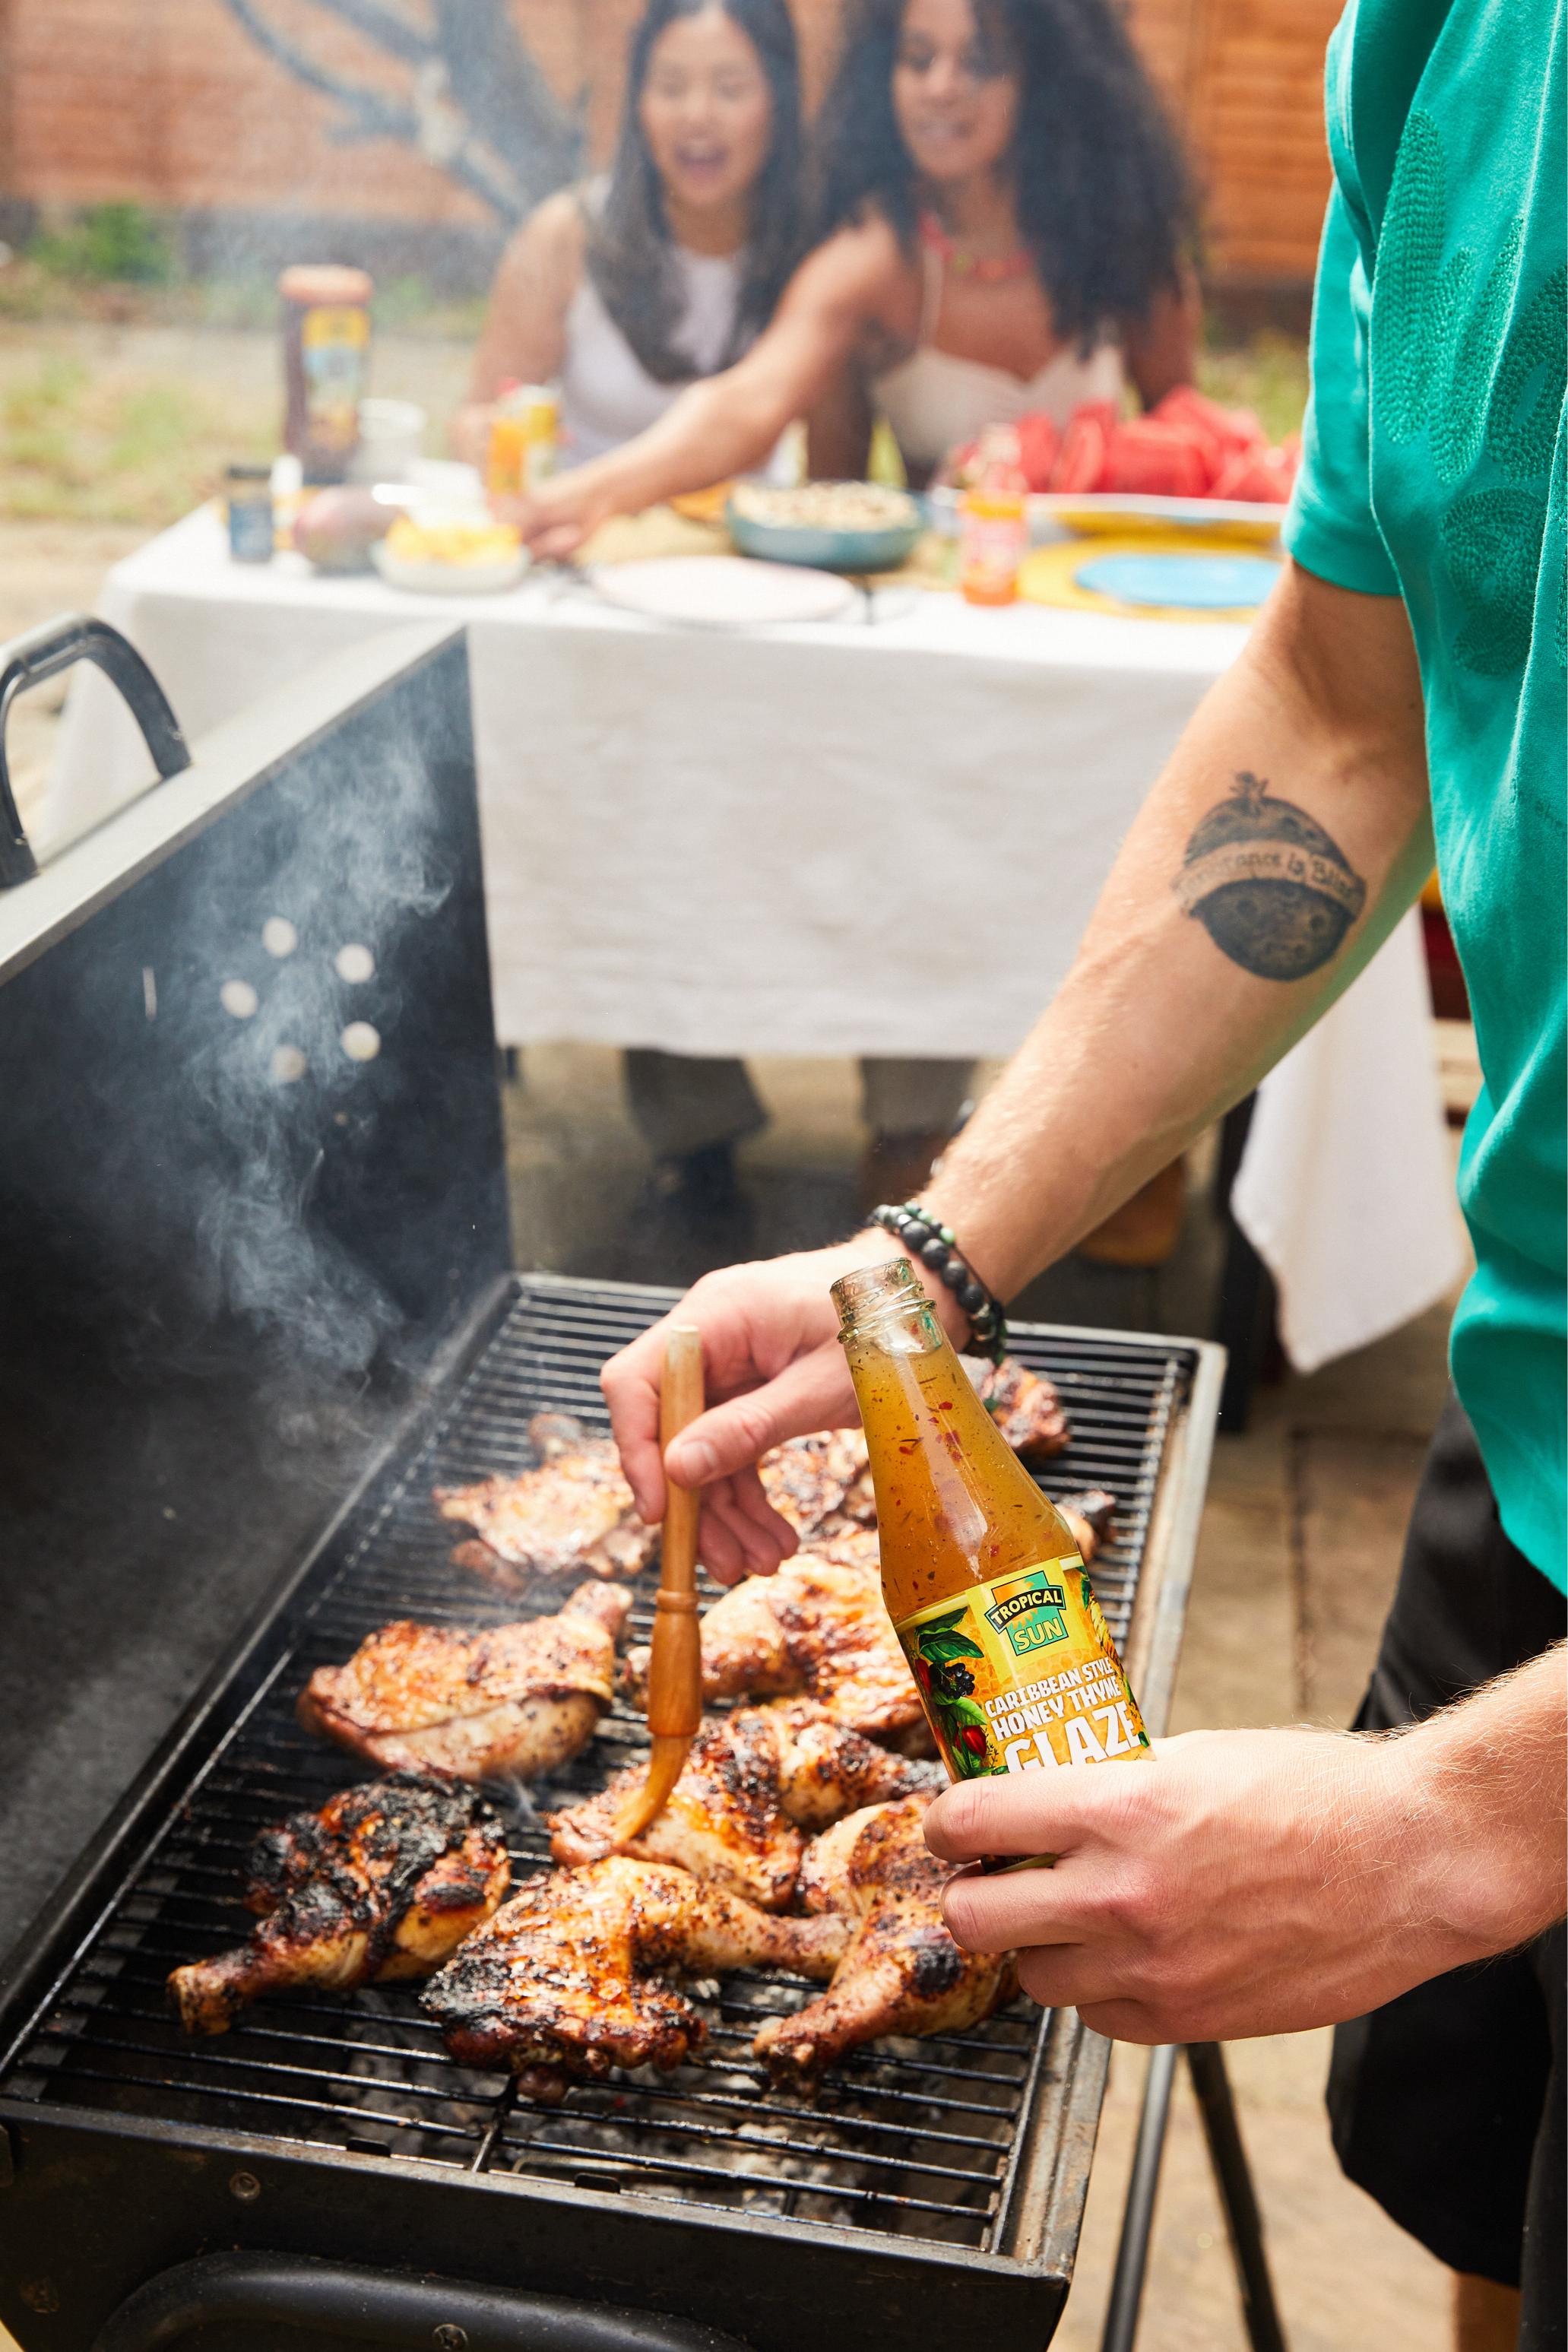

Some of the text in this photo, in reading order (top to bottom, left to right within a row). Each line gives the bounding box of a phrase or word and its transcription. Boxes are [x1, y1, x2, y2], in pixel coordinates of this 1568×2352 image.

[990, 1590, 1063, 1625] TROPICAL
[1013, 1617, 1064, 1651] SUN
[984, 1656, 1114, 1718] CARIBBEAN STYLE
[990, 1675, 1122, 1742] HONEY THYME
[1004, 1700, 1141, 1774] GLAZE
